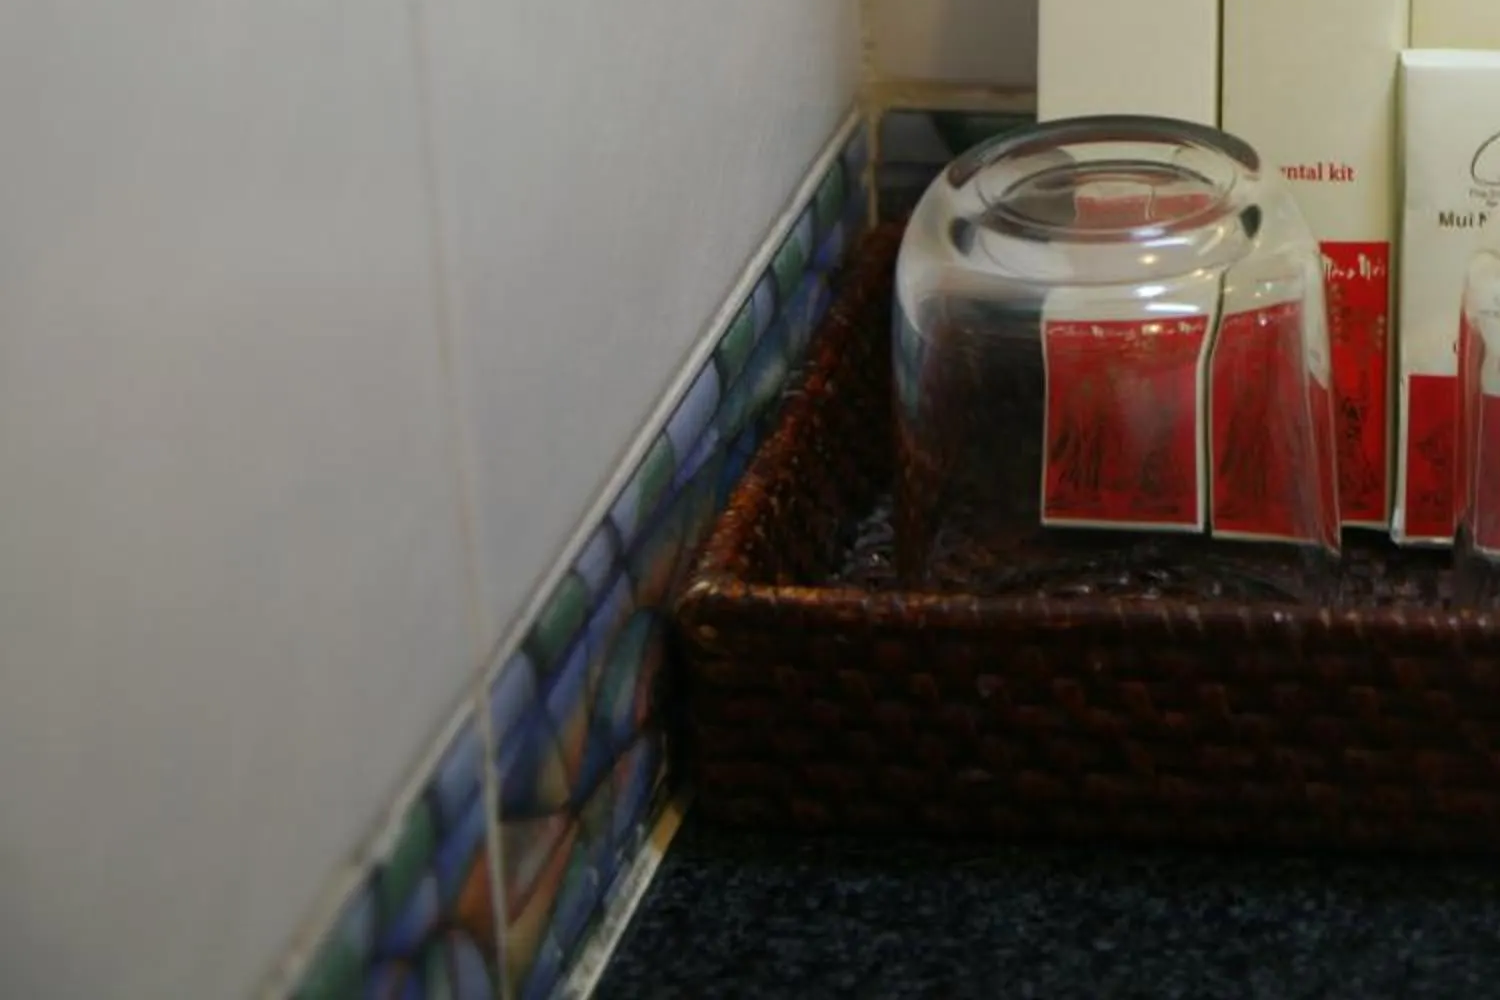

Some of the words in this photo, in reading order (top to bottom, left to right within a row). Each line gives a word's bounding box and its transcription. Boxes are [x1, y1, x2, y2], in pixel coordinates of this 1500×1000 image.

[1280, 161, 1323, 181] ntal
[1328, 162, 1355, 182] kit
[1438, 210, 1474, 229] Mui
